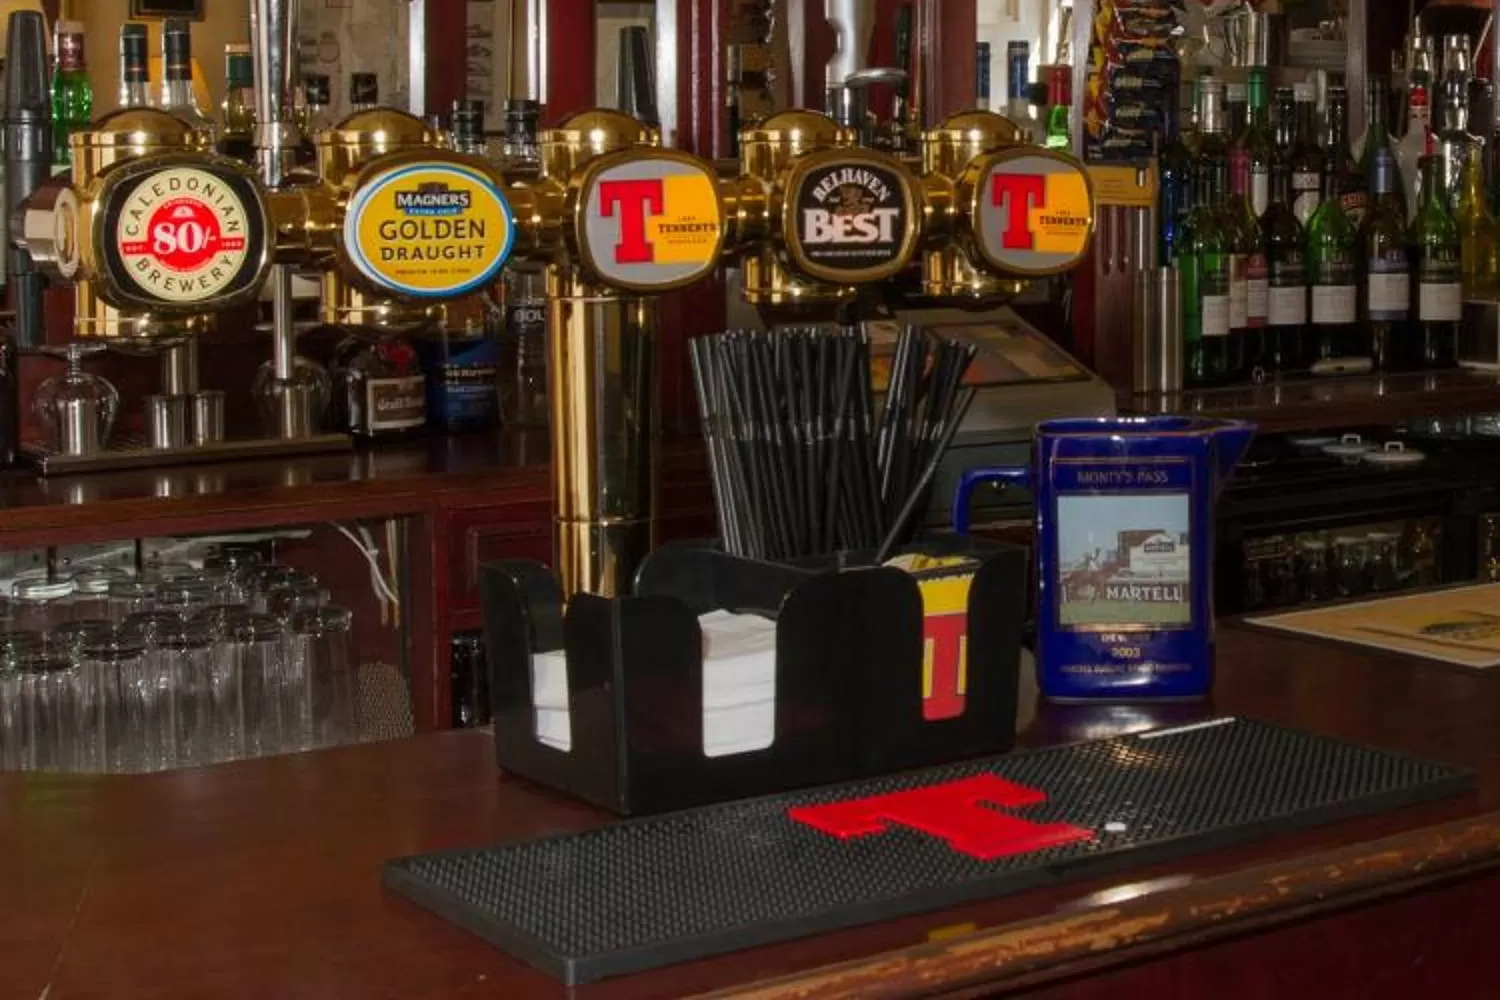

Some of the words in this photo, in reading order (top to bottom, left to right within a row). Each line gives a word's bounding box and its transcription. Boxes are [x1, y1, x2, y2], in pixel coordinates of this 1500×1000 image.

[397, 192, 470, 208] MAGNERS
[812, 167, 892, 203] BELHAVEN
[125, 177, 241, 236] CALEDONIAN
[599, 178, 664, 264] T
[992, 174, 1045, 249] T
[379, 219, 486, 240] GOLDEN
[803, 207, 900, 243] BEST
[380, 244, 486, 261] DRAUGHT
[136, 255, 233, 293] BREWERY
[1137, 470, 1169, 484] PASS
[1105, 585, 1182, 602] MARTELL
